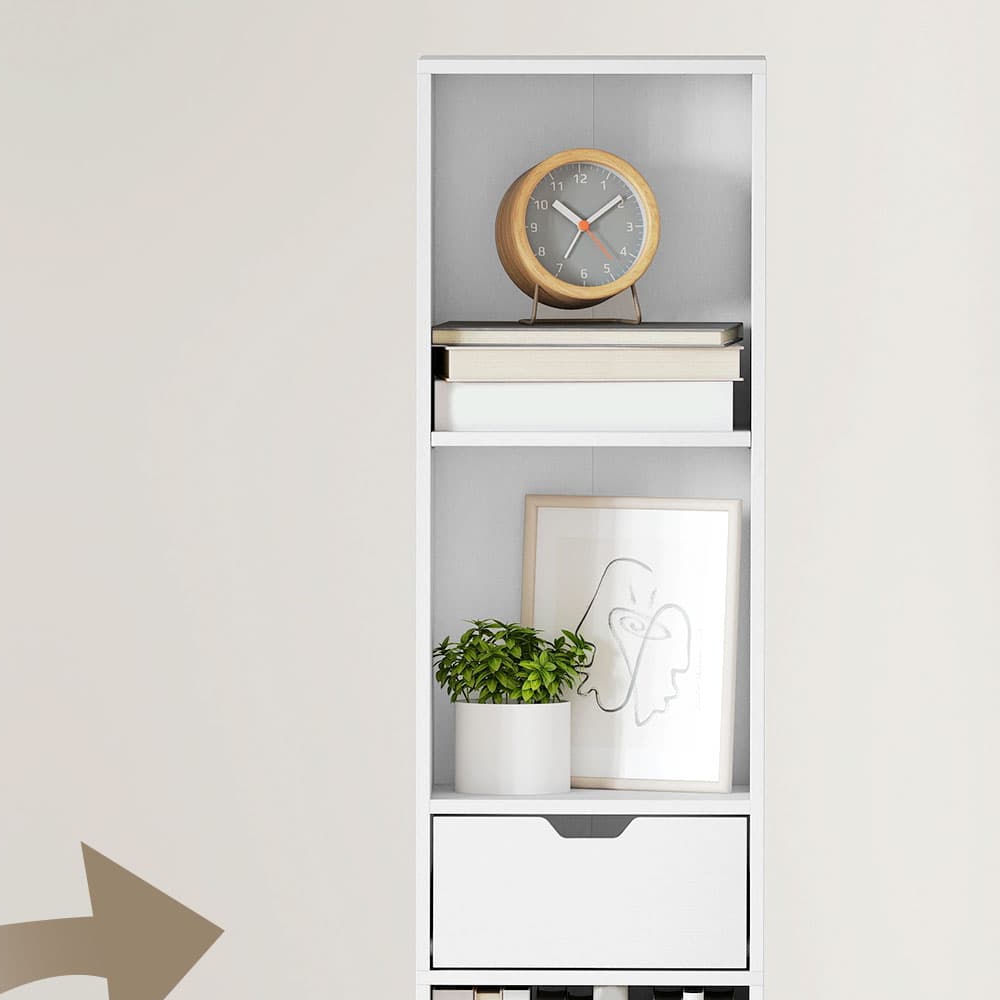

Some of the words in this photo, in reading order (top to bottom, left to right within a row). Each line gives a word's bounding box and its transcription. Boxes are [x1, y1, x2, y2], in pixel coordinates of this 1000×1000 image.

[573, 174, 588, 184] 12
[551, 182, 564, 191] 11
[600, 180, 606, 191] 1
[534, 200, 549, 210] 10
[530, 223, 538, 233] 9
[626, 222, 633, 232] 3
[538, 247, 545, 256] 8
[619, 247, 627, 256] 4
[556, 263, 563, 273] 7
[603, 264, 610, 273] 5
[580, 269, 588, 279] 6
